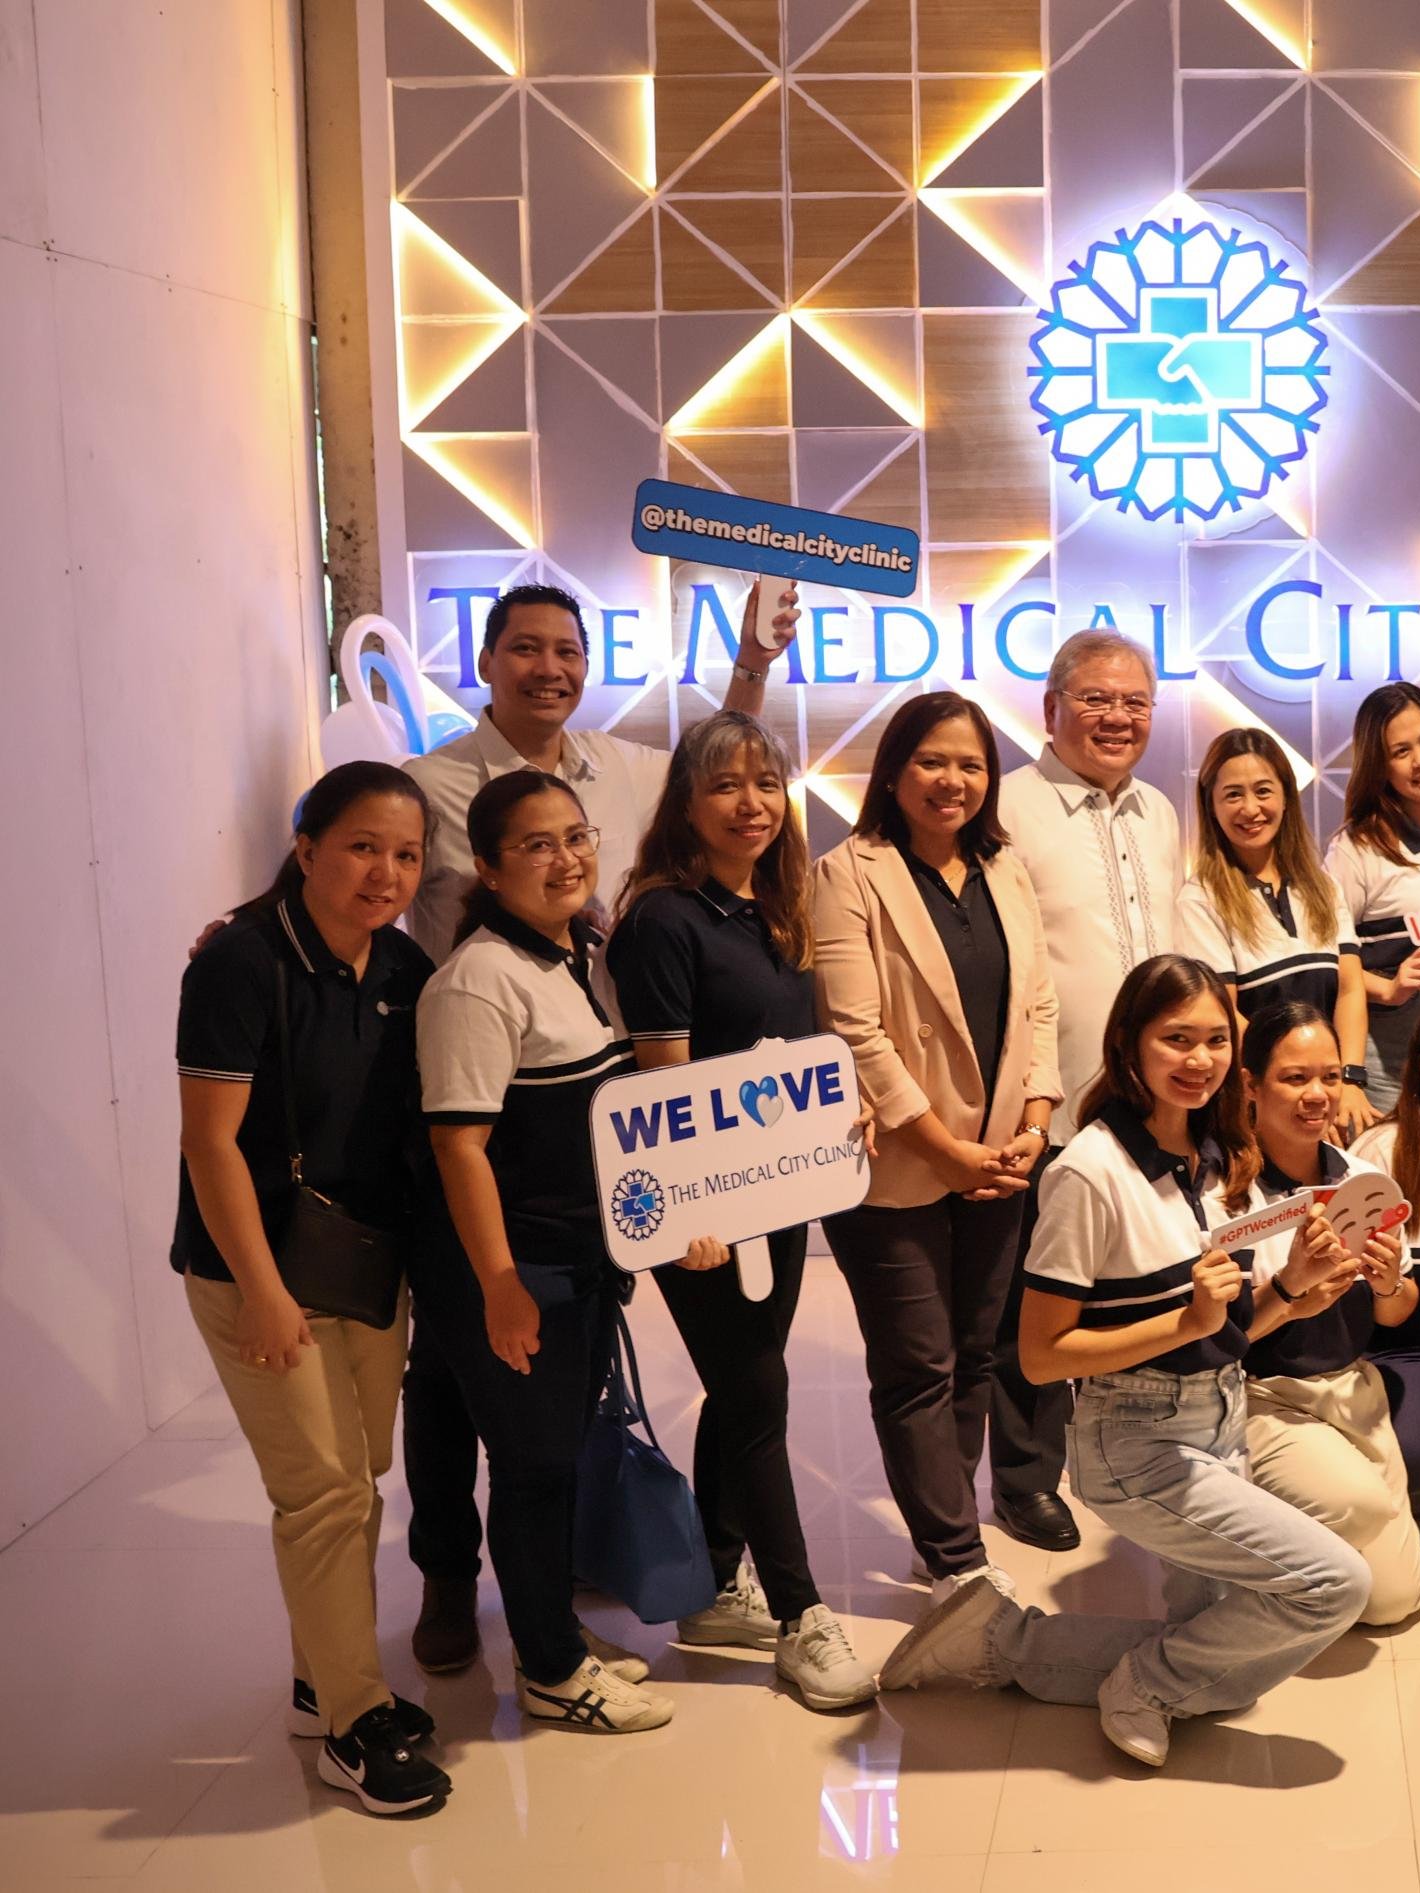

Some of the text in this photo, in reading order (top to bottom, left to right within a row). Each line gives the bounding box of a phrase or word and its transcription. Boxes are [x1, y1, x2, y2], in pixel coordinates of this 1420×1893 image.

[640, 504, 912, 572] @themedicalcityclinic
[429, 586, 648, 688] TE
[609, 1095, 696, 1154] WE
[668, 1140, 863, 1206] THE MEDICAL CITY CLINIC
[1219, 1202, 1307, 1245] #GPTWcertified
